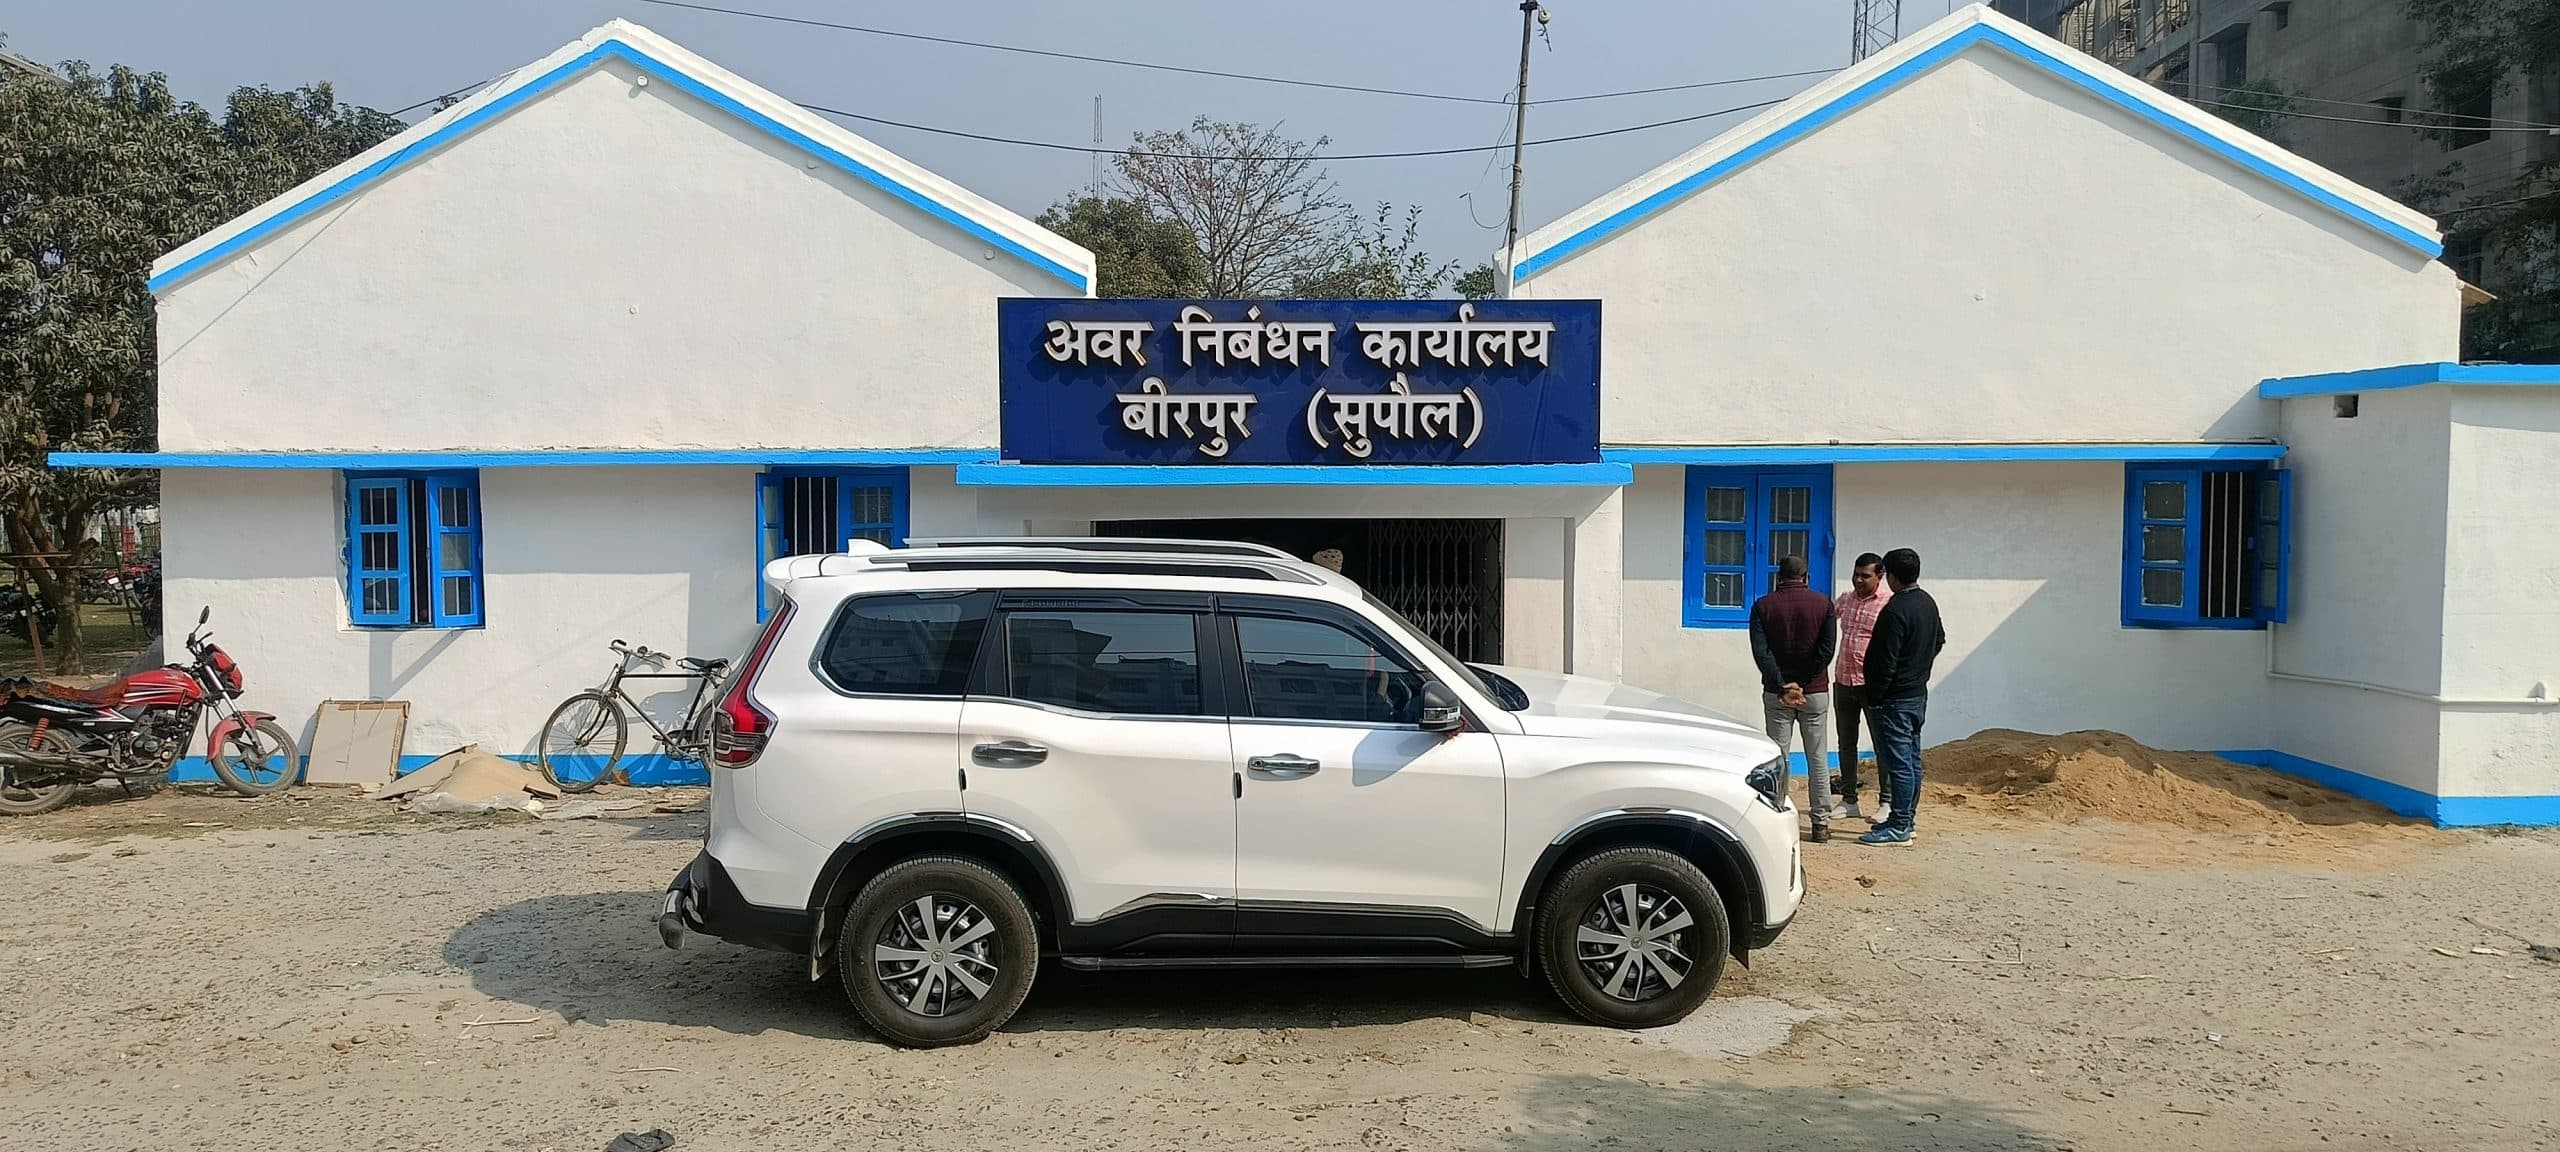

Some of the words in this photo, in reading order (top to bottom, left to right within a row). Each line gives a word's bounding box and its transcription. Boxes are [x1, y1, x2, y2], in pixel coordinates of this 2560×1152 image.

[1044, 319, 1154, 367] अवर
[1172, 305, 1336, 368] निबंधन
[1354, 303, 1556, 368] कार्यालय
[1115, 376, 1258, 455] बीरपुर
[1306, 372, 1484, 457] (सुपौल)
